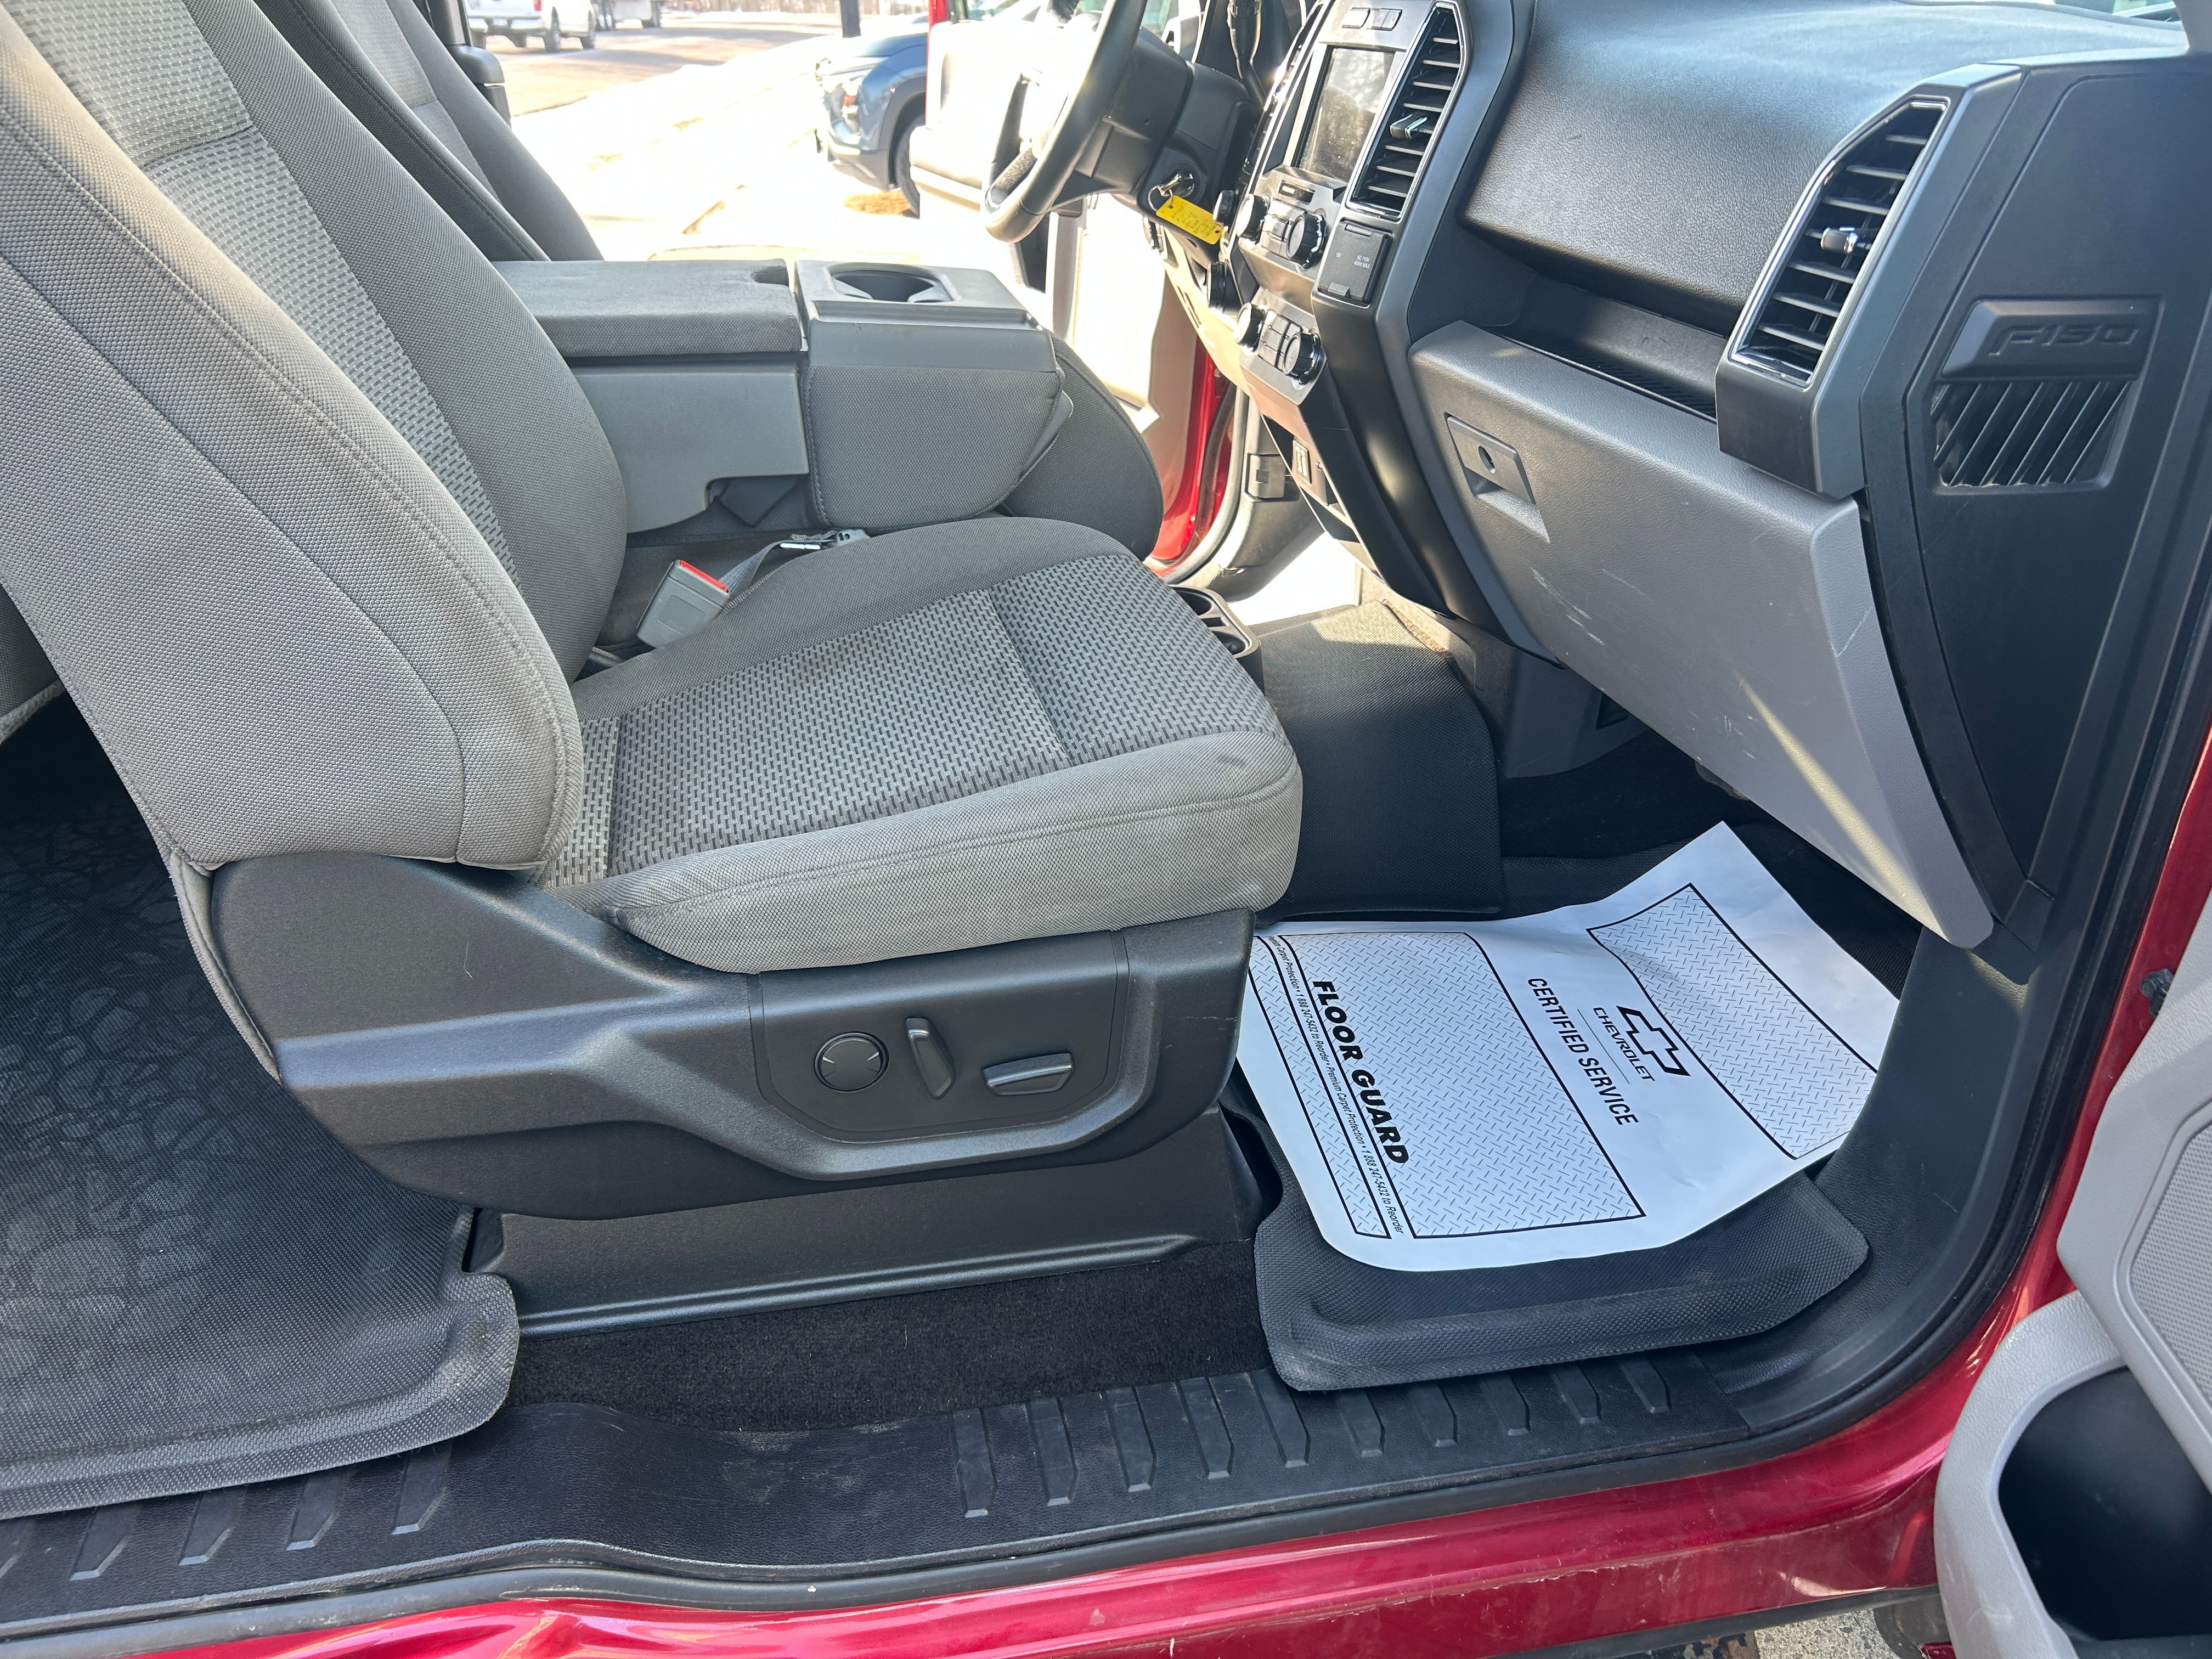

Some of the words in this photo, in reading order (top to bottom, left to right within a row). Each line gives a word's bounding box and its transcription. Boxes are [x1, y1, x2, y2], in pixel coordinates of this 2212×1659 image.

[1277, 947, 1290, 961] Carpet
[1284, 962, 1300, 989] Protection
[1297, 998, 1309, 1008] 888
[1301, 1009, 1319, 1034] 247-5432
[1314, 1040, 1330, 1062] Reorder
[1528, 978, 1589, 1053] CERTIFIED
[1578, 1058, 1639, 1125] SERVICE
[1593, 1007, 1656, 1081] CHEVROLET
[1312, 981, 1363, 1061] FLOOR
[1351, 1069, 1409, 1164] GUARD
[1325, 1066, 1342, 1092] Premium
[1337, 1093, 1353, 1113] Carpet
[1346, 1114, 1365, 1144] Protection
[1364, 1155, 1377, 1166] 888
[1369, 1167, 1390, 1198] 247-5432
[1385, 1206, 1404, 1234] Reorder
